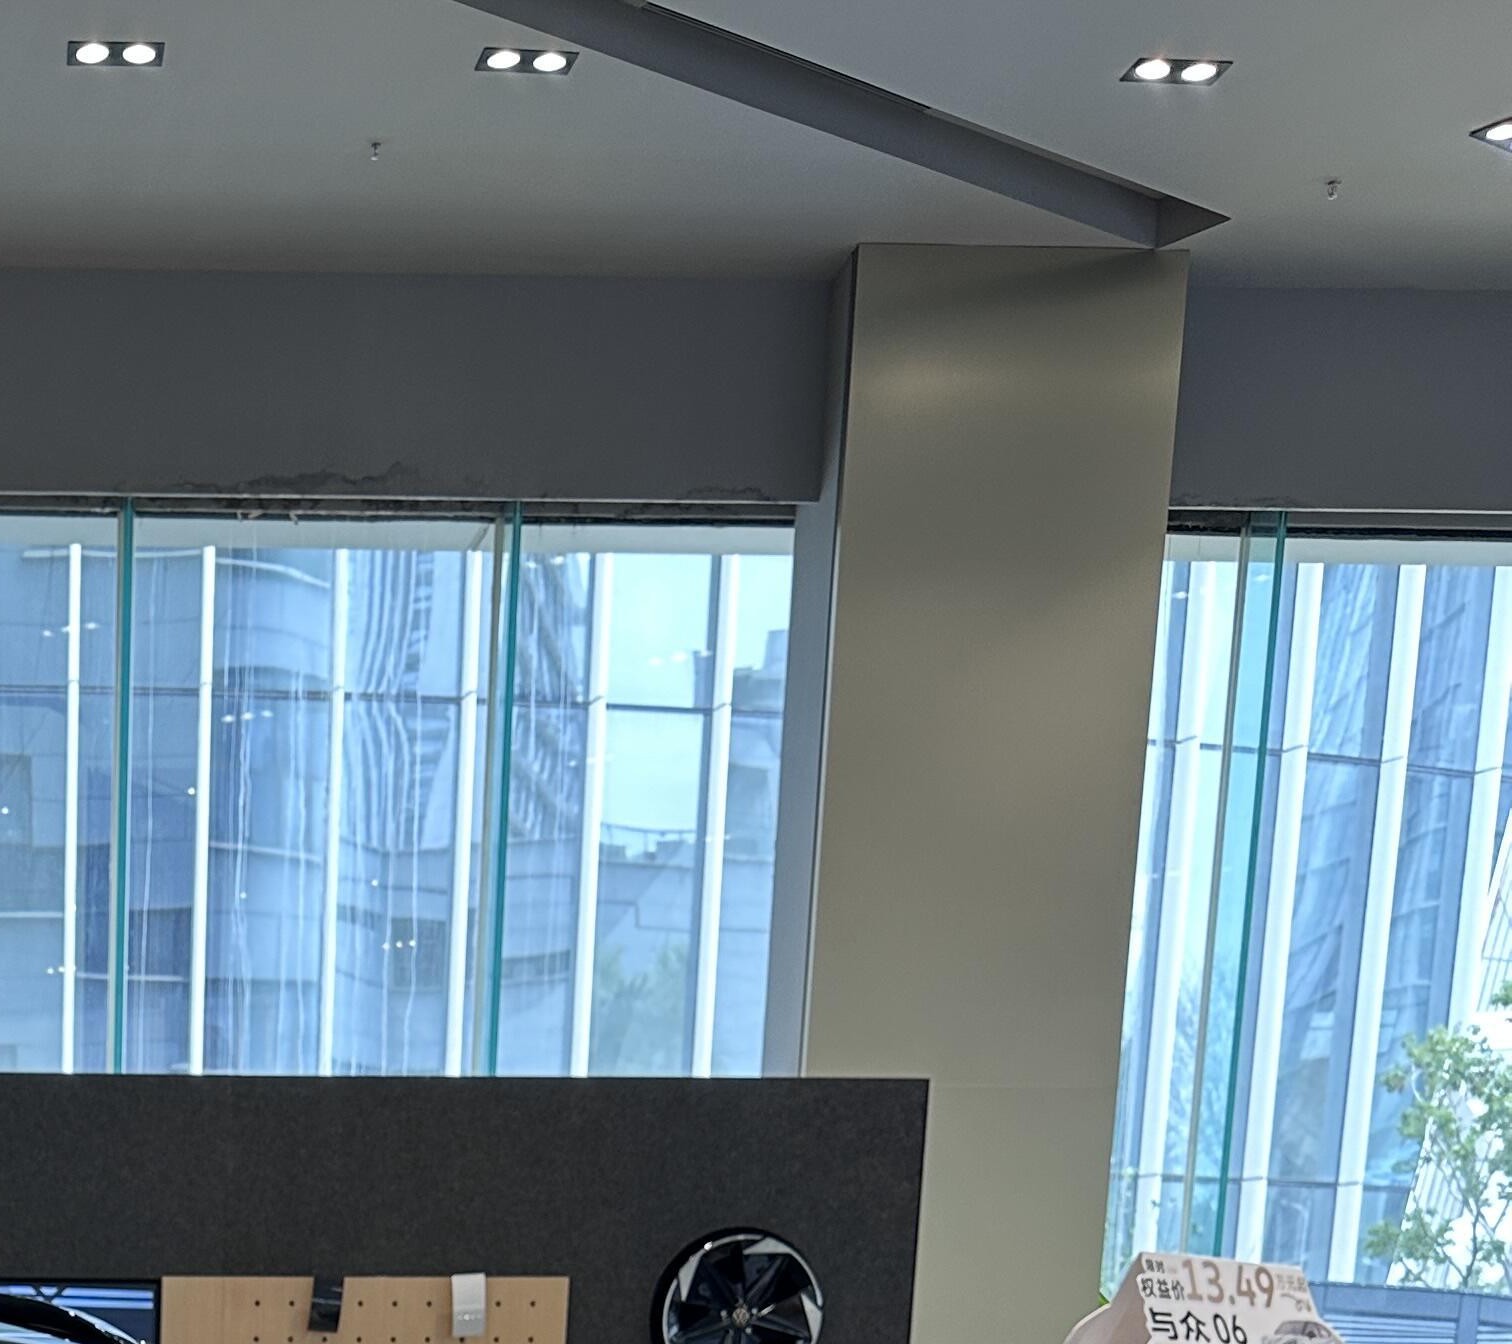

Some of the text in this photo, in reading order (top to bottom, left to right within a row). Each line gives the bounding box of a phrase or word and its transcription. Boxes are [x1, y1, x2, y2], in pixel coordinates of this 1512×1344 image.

[1140, 1277, 1186, 1302] 权益价
[1181, 1259, 1274, 1309] 13.49
[1149, 1307, 1211, 1344] 与众
